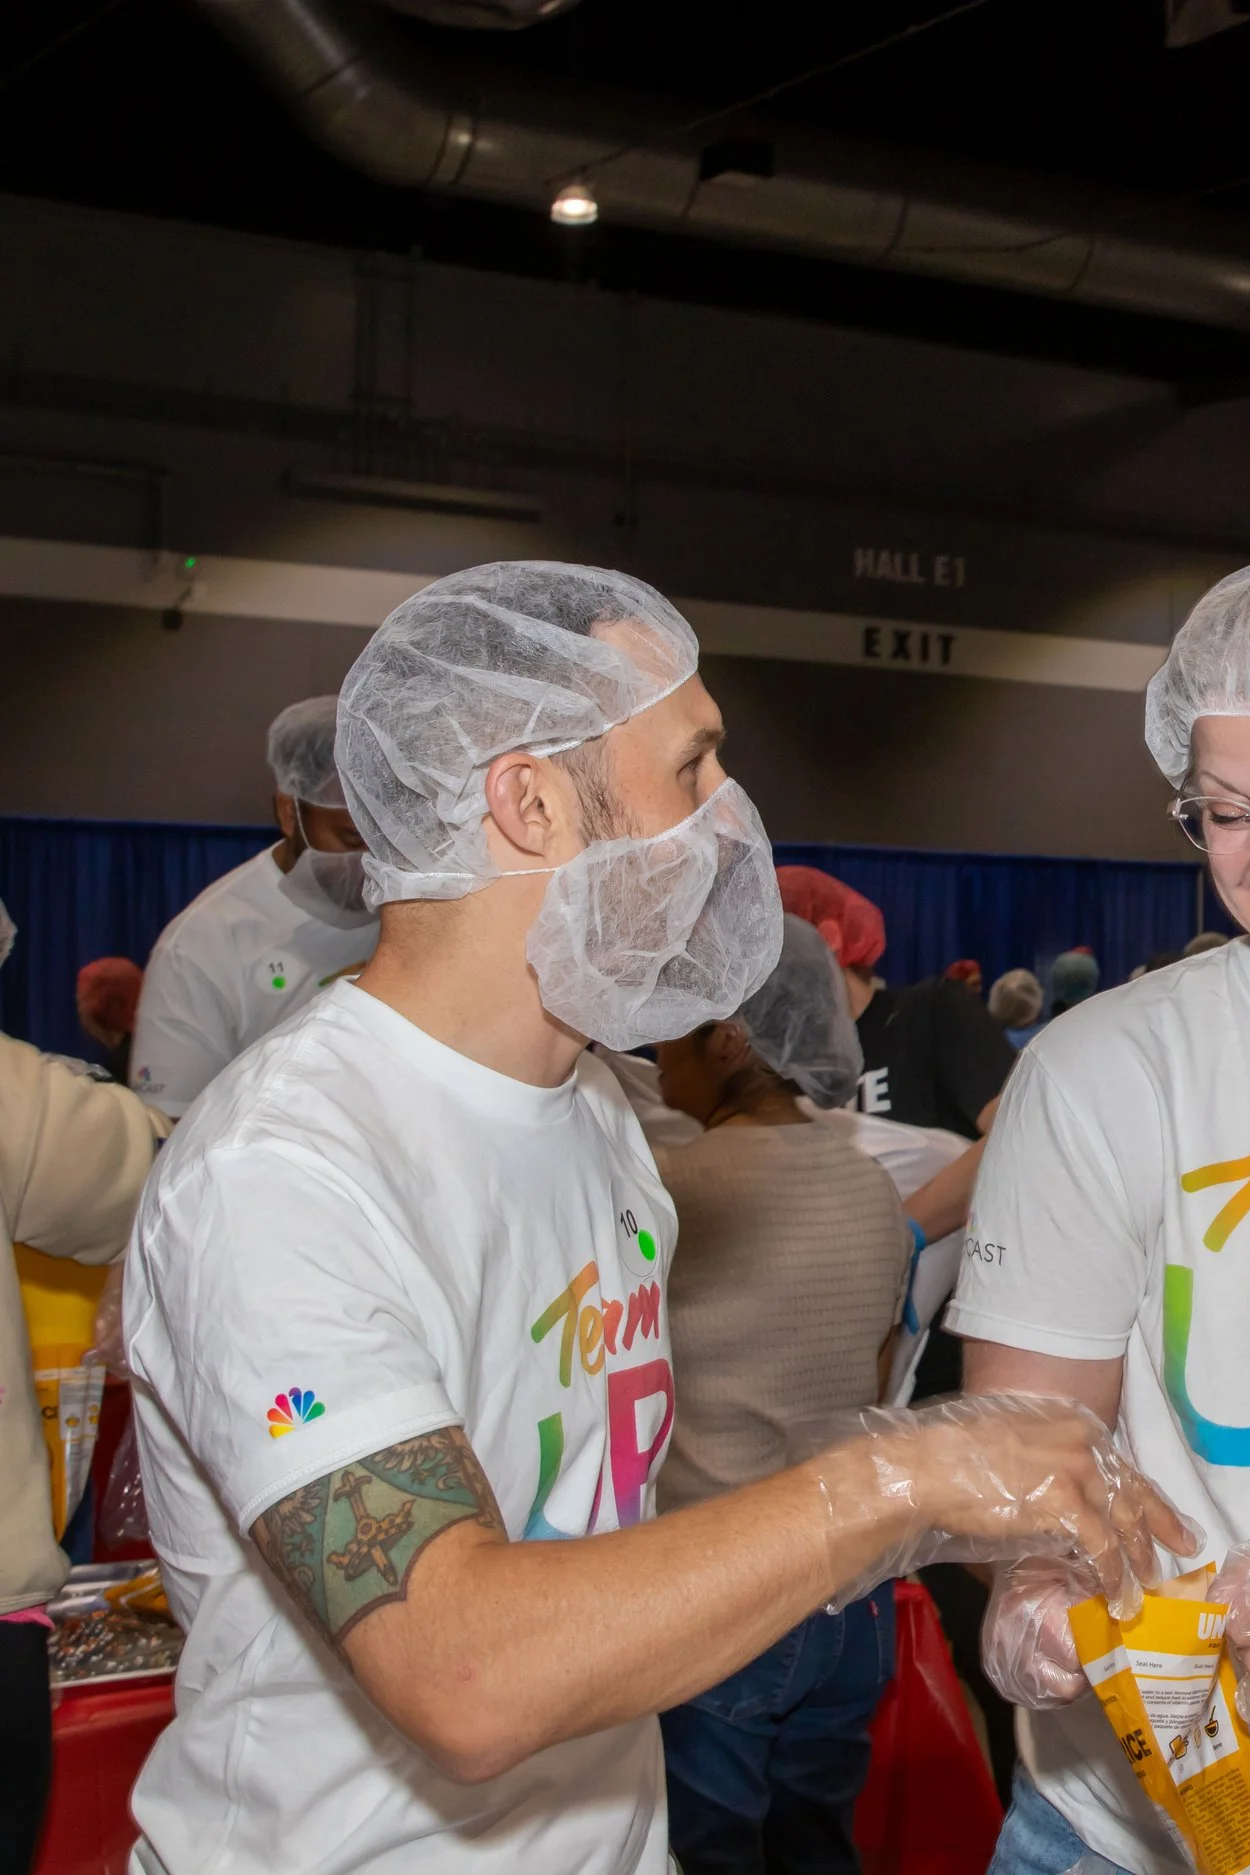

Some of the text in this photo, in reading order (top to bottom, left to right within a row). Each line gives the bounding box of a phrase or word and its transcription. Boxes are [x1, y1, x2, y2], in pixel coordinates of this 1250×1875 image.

[854, 548, 966, 588] HALL E1
[865, 626, 957, 665] EXIT
[268, 961, 285, 975] 11
[620, 1208, 639, 1239] 10
[1136, 1660, 1149, 1668] Seal
[1120, 1728, 1153, 1765] ICE
